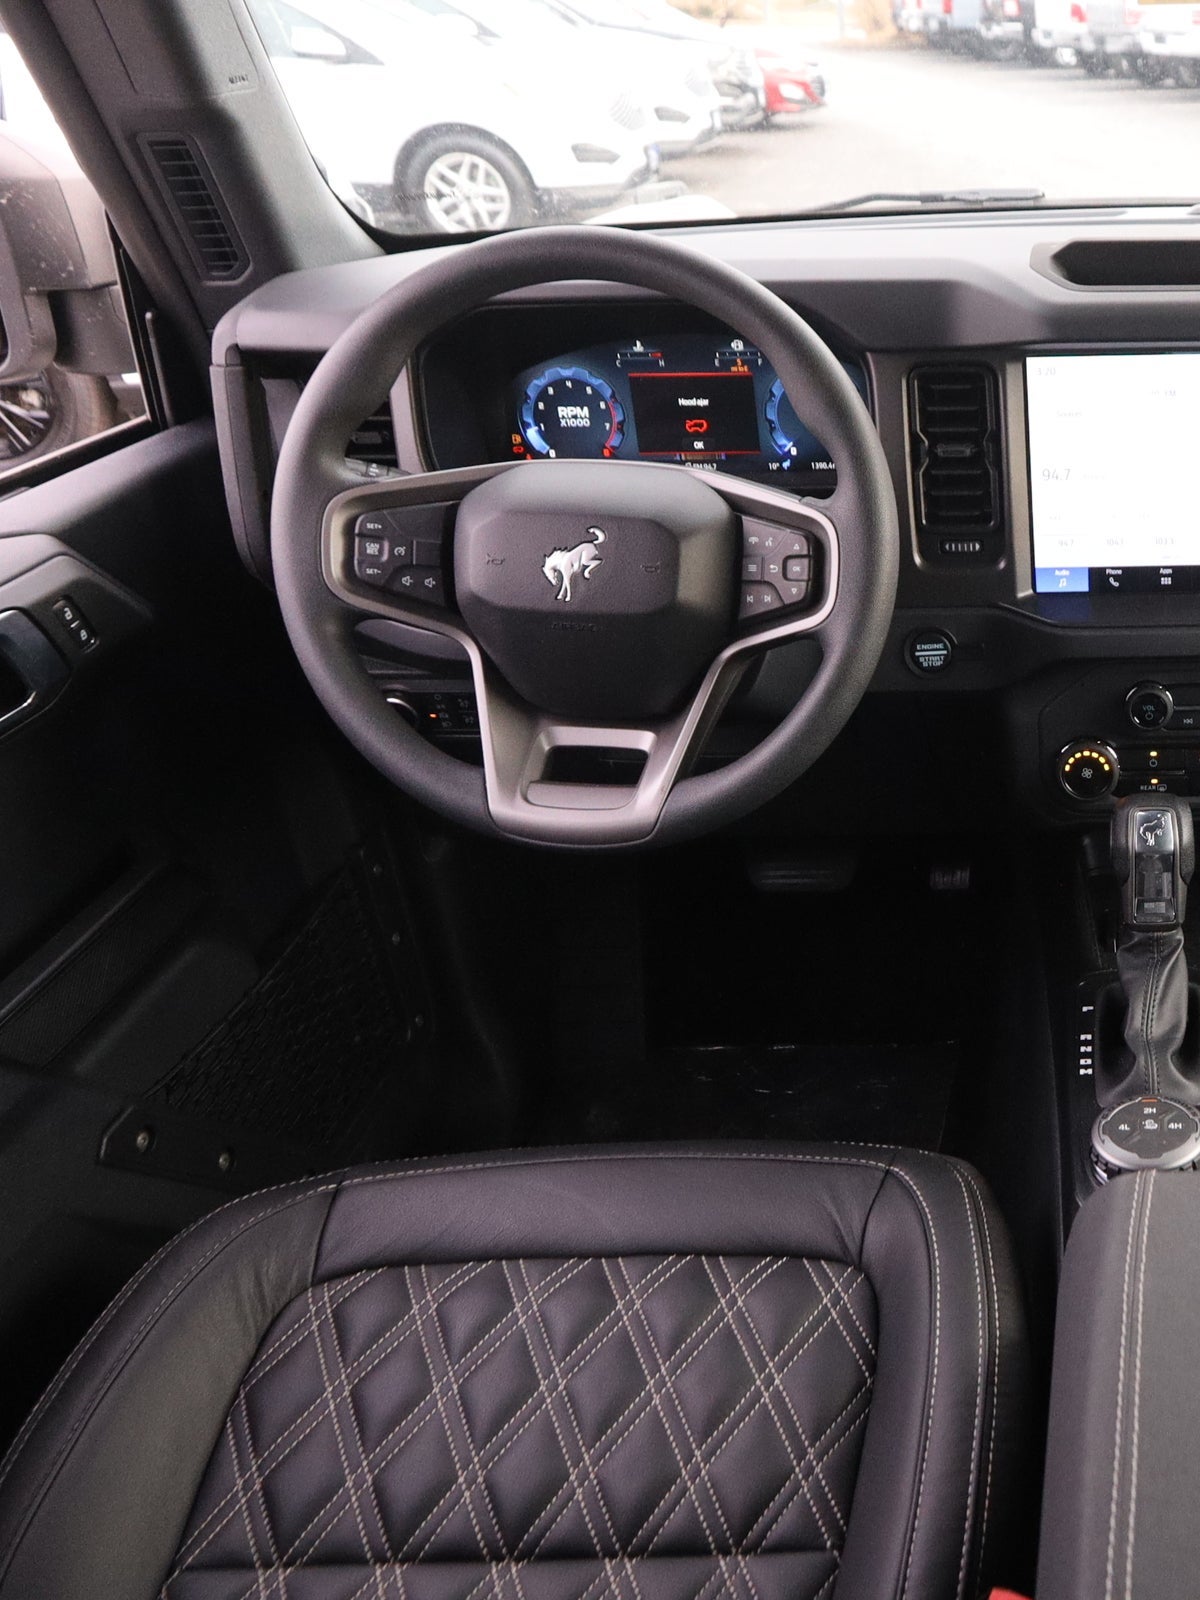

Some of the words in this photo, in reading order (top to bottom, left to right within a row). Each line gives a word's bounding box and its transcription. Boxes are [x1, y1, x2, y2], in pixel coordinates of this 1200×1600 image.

[565, 380, 573, 389] 4
[585, 386, 592, 395] 5
[677, 397, 696, 406] Hood
[696, 398, 709, 407] ajar
[557, 406, 590, 418] RPM
[560, 418, 591, 428] X1000
[604, 422, 610, 431] 7
[1042, 467, 1071, 481] 94.7
[1160, 568, 1172, 576] Apps
